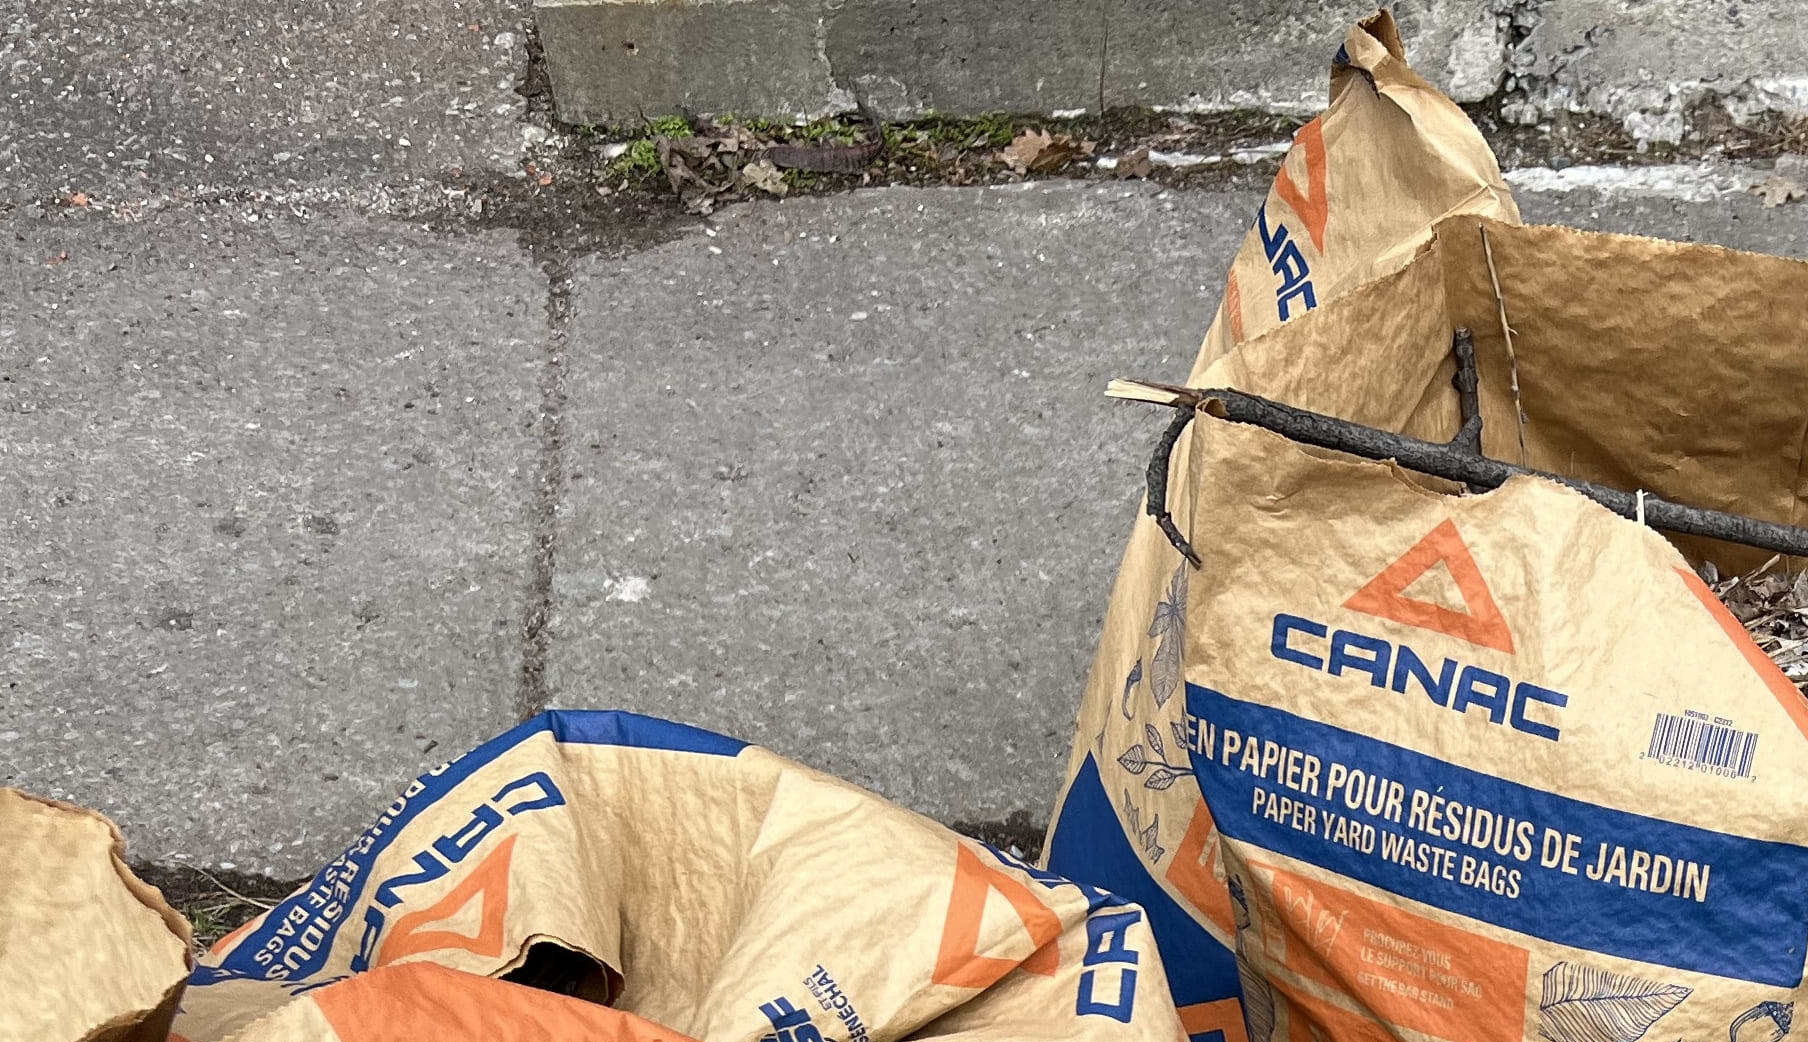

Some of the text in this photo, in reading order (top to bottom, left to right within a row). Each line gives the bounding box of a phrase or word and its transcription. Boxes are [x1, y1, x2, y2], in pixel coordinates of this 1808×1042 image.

[1254, 200, 1318, 322] NAC
[1270, 612, 1570, 743] CANAC
[1186, 713, 1712, 904] EN PAPIER POUR RÉSIDUS DE JARDIN
[1658, 756, 1696, 771] 02212
[1701, 764, 1738, 780] 01006
[253, 840, 366, 967] ASTE BAGS
[290, 771, 566, 995] CANA
[1251, 787, 1524, 901] PAPER YARD WASTE BAGS
[265, 858, 361, 981] RÉSIDUS
[1361, 946, 1375, 964] LE
[1376, 951, 1429, 980] SUPPORT
